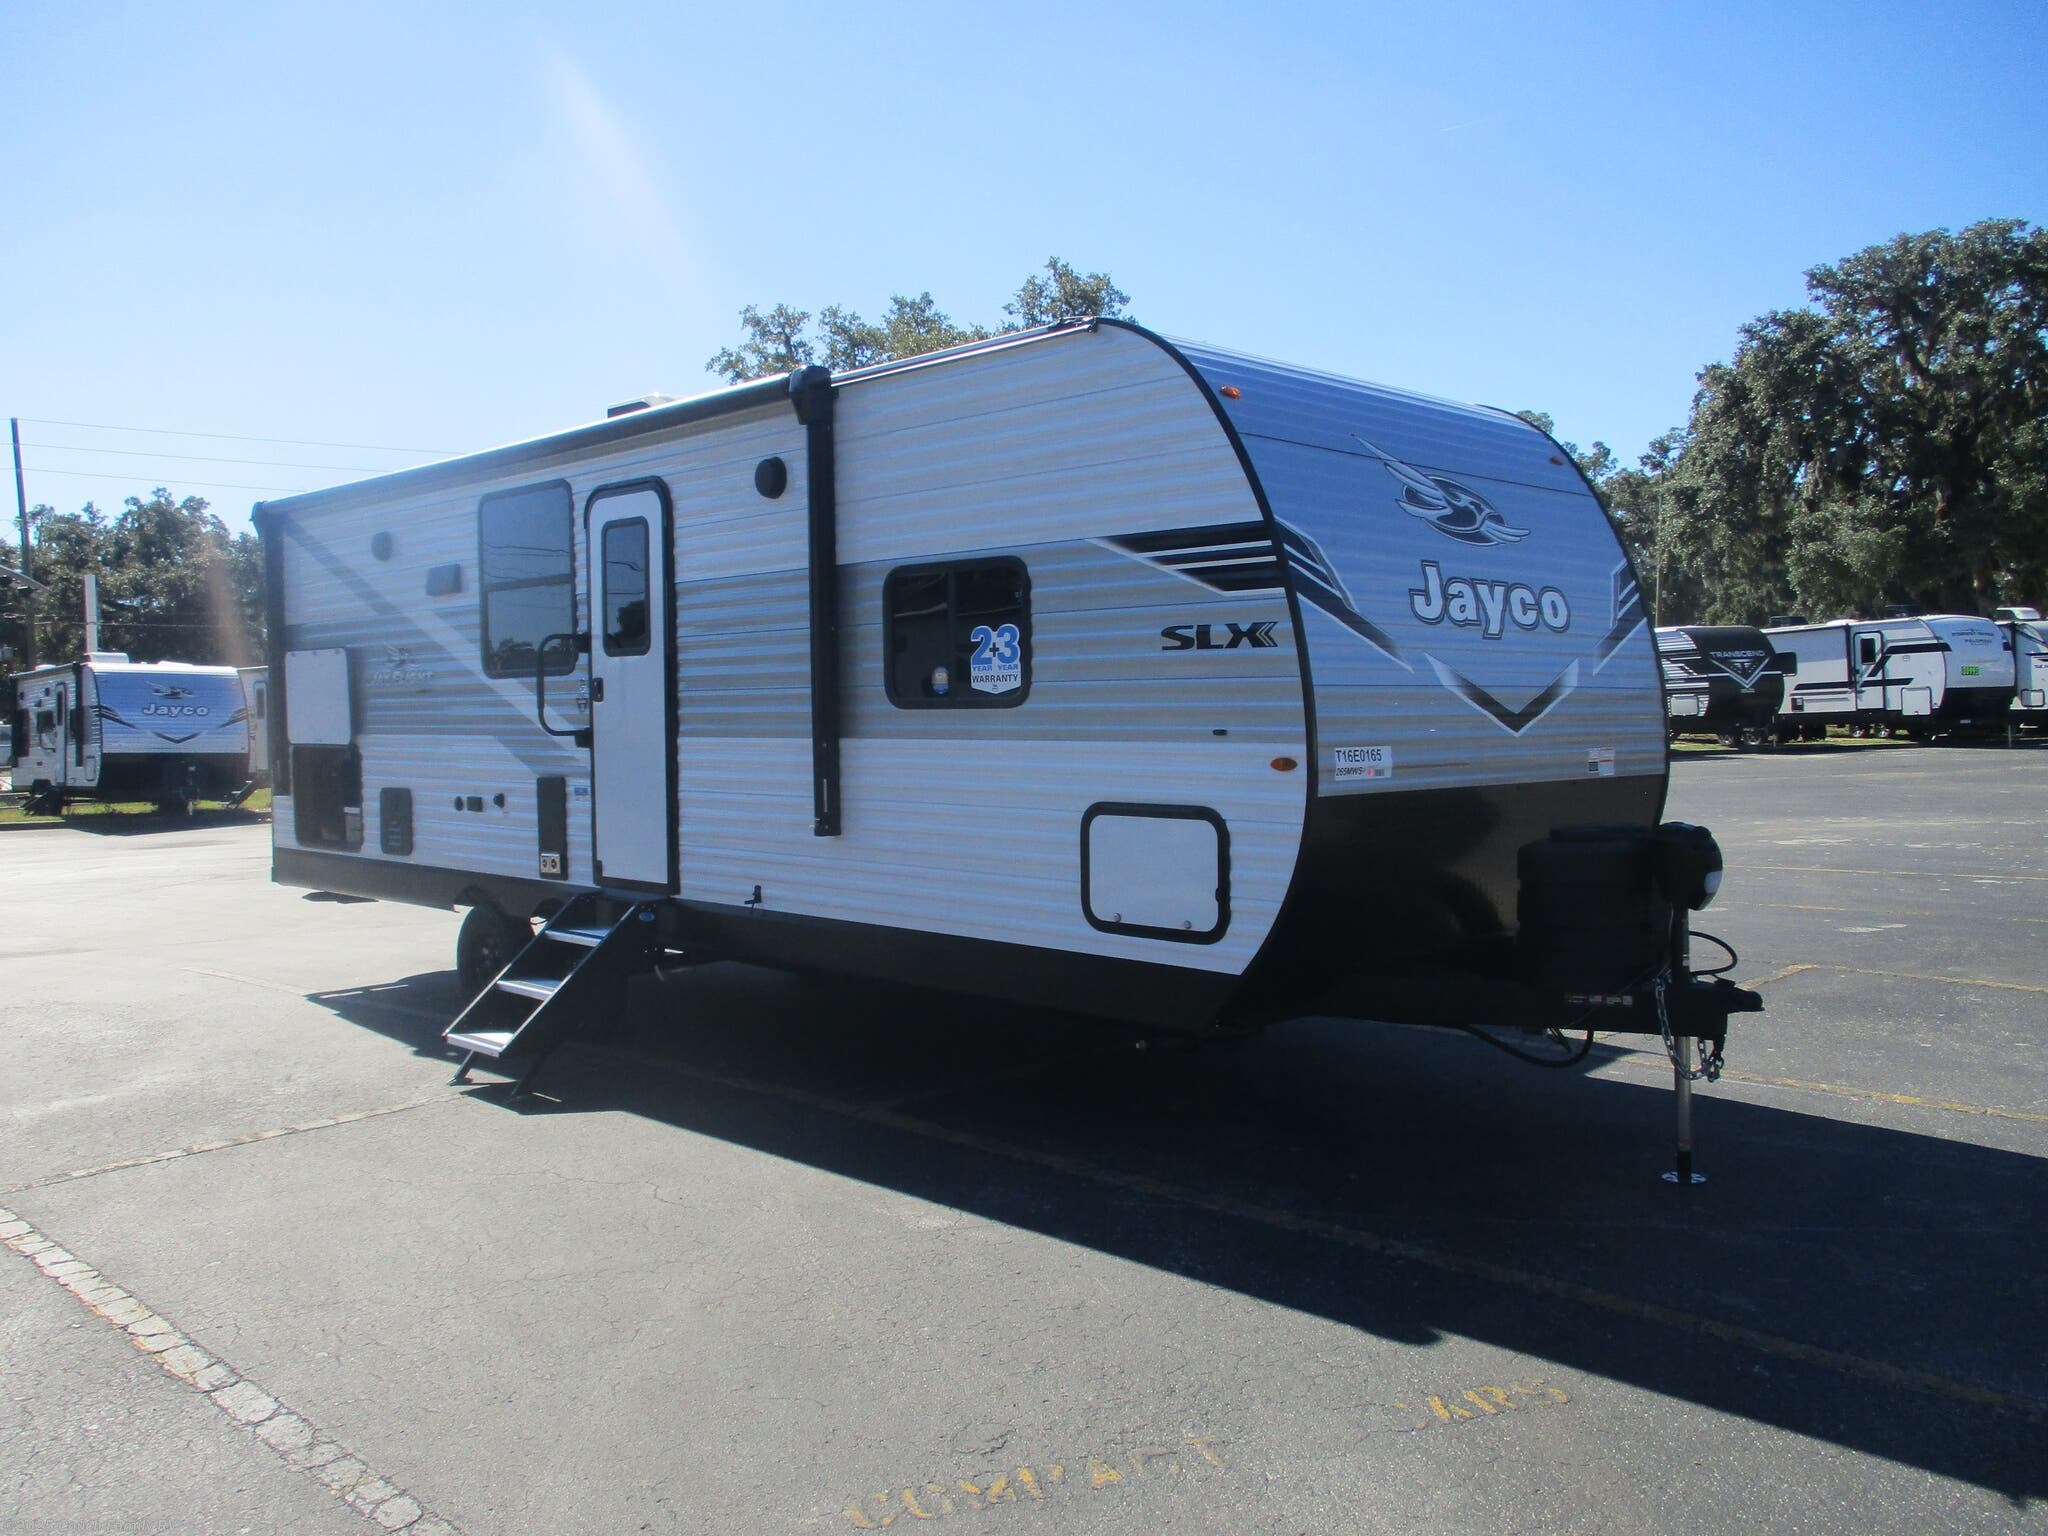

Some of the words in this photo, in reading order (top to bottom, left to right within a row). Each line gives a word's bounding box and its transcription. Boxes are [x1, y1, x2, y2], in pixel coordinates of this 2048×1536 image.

[1408, 560, 1571, 640] Jayco
[1161, 621, 1279, 650] SLX
[1709, 650, 1766, 658] TRANSCEND
[997, 663, 1019, 671] YEAR
[972, 674, 1018, 683] WARRANTY
[143, 703, 209, 717] Jayco
[1335, 748, 1382, 763] T16E0165
